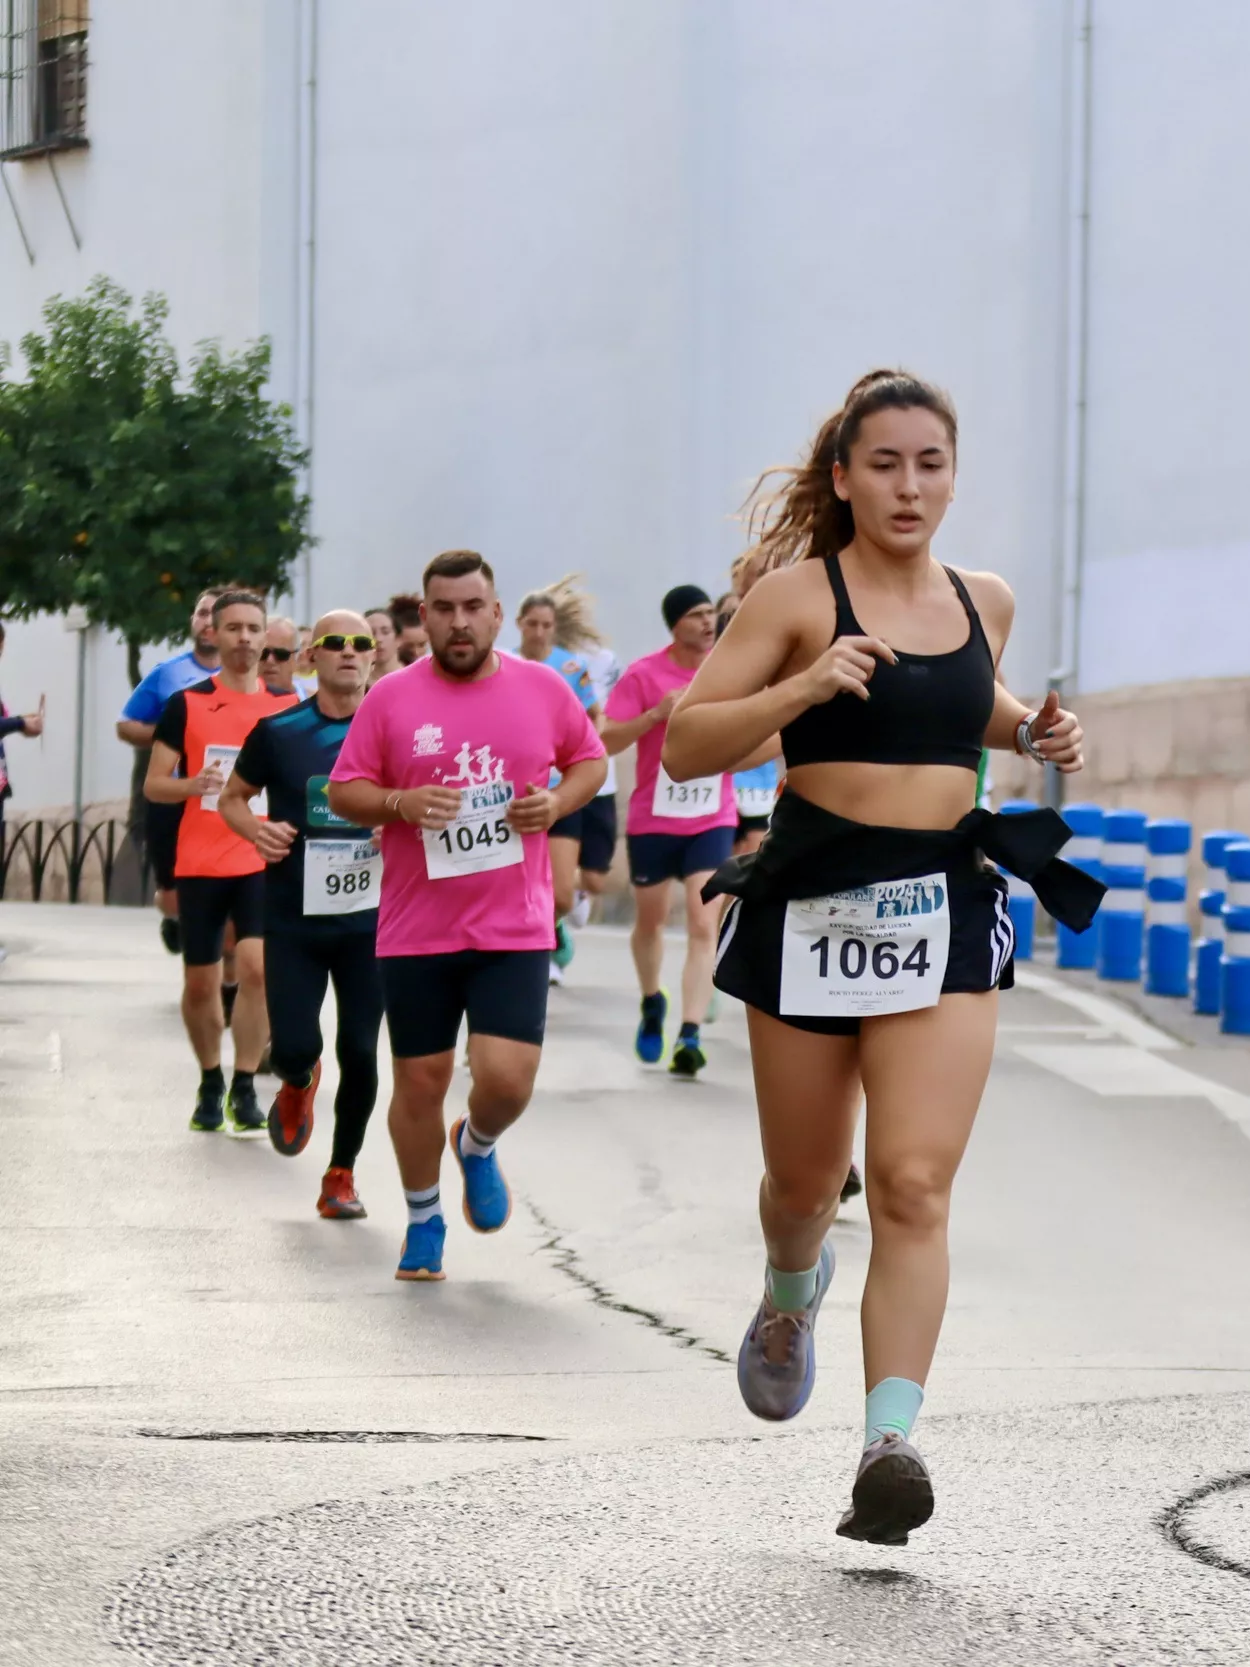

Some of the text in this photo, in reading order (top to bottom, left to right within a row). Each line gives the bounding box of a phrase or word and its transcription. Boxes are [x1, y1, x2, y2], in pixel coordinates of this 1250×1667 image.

[666, 785, 712, 803] 1317
[439, 819, 510, 854] 1045
[326, 870, 370, 895] 988
[876, 884, 915, 902] 2024
[810, 936, 931, 980] 1064
